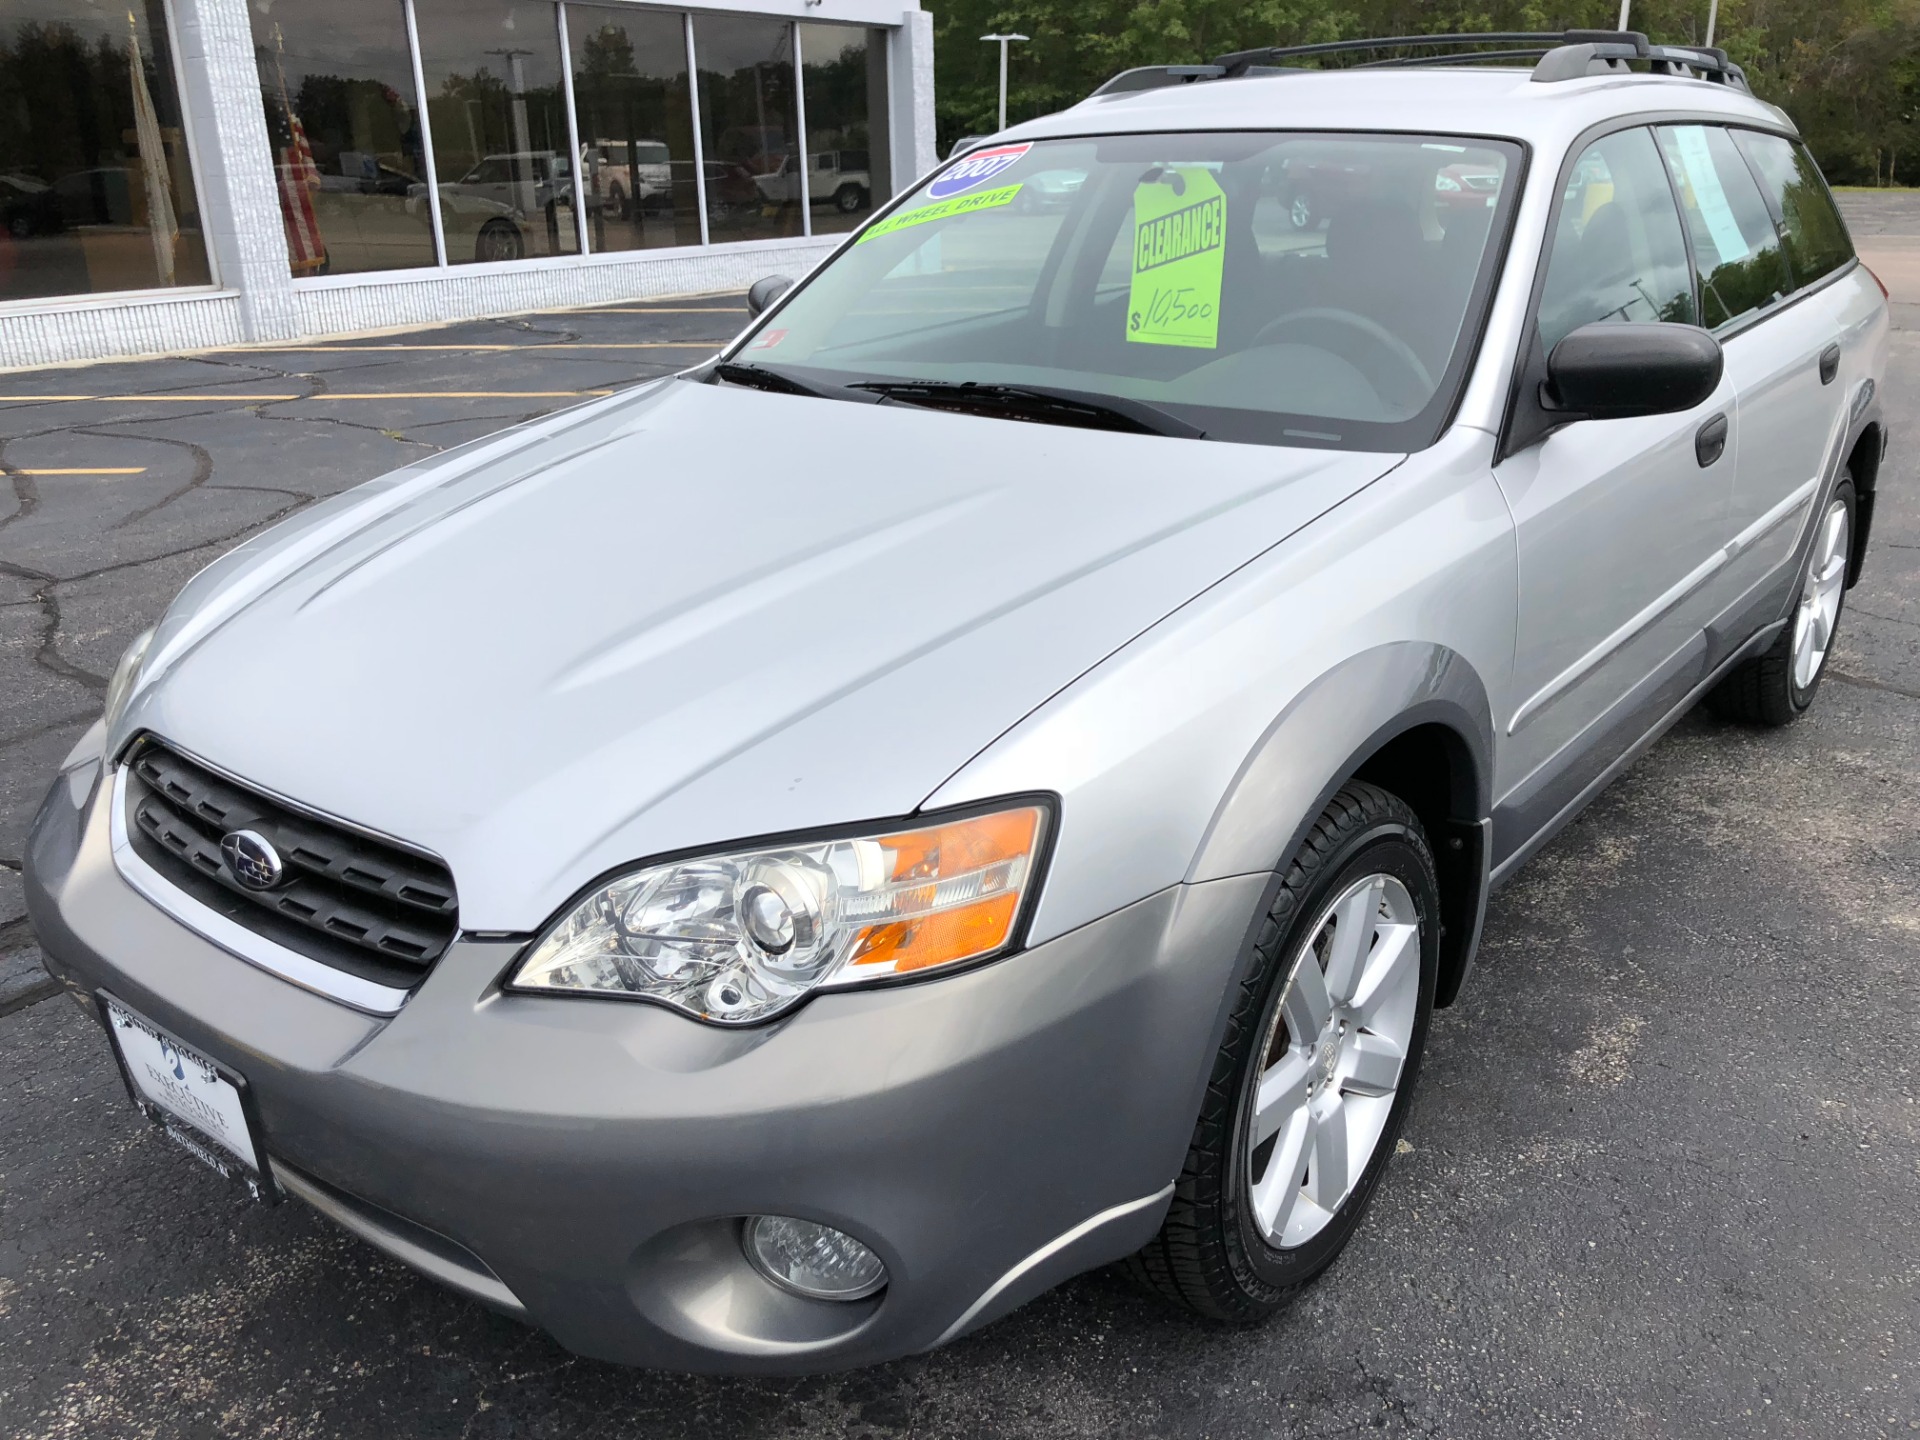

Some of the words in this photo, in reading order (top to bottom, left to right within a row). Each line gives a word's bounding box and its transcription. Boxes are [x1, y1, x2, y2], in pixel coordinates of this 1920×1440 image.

[937, 153, 1020, 182] 2007
[895, 204, 951, 226] WHEEL
[956, 188, 1018, 210] DRIVE
[1138, 200, 1220, 270] CLEARANCE
[145, 1062, 230, 1129] EXECUTIVE
